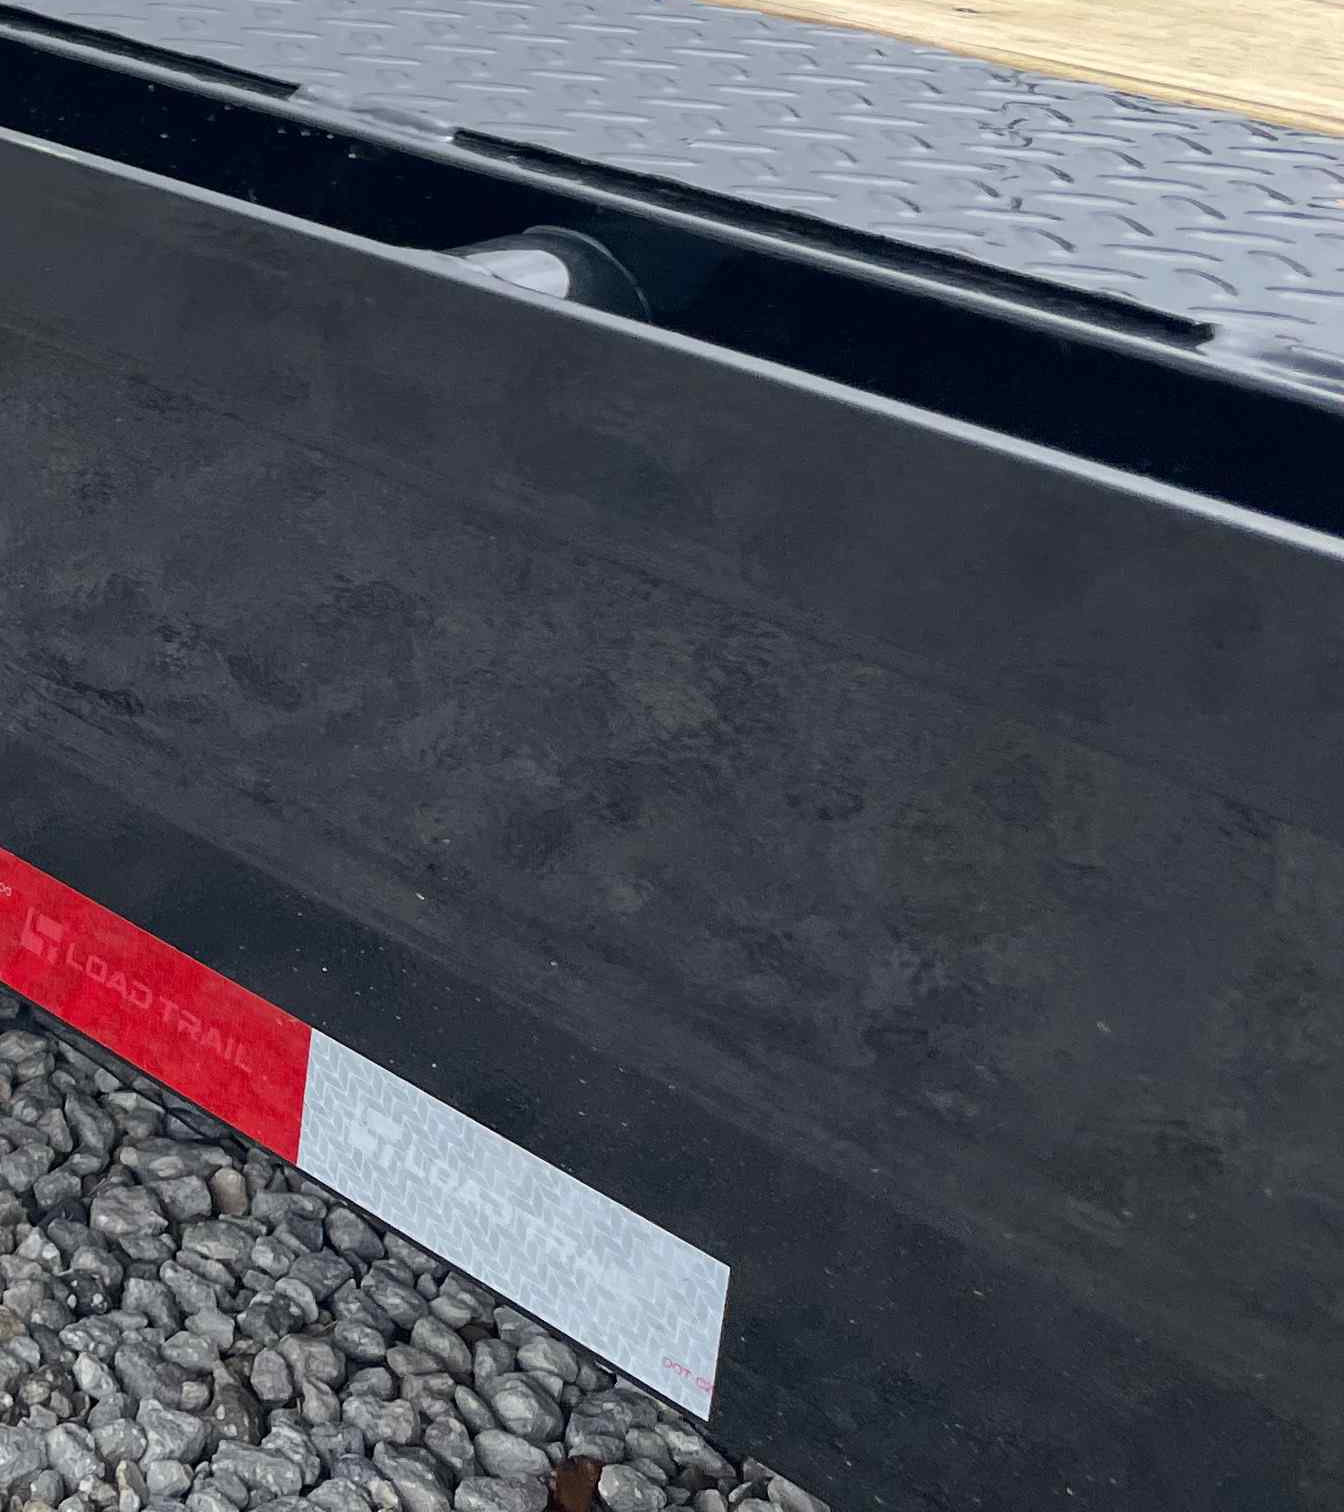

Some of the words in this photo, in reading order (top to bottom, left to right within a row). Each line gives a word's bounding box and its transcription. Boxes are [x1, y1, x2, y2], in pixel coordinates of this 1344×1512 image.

[66, 942, 153, 1009] LOAD
[157, 995, 253, 1074] TRAIL
[406, 1148, 516, 1225] LOAD
